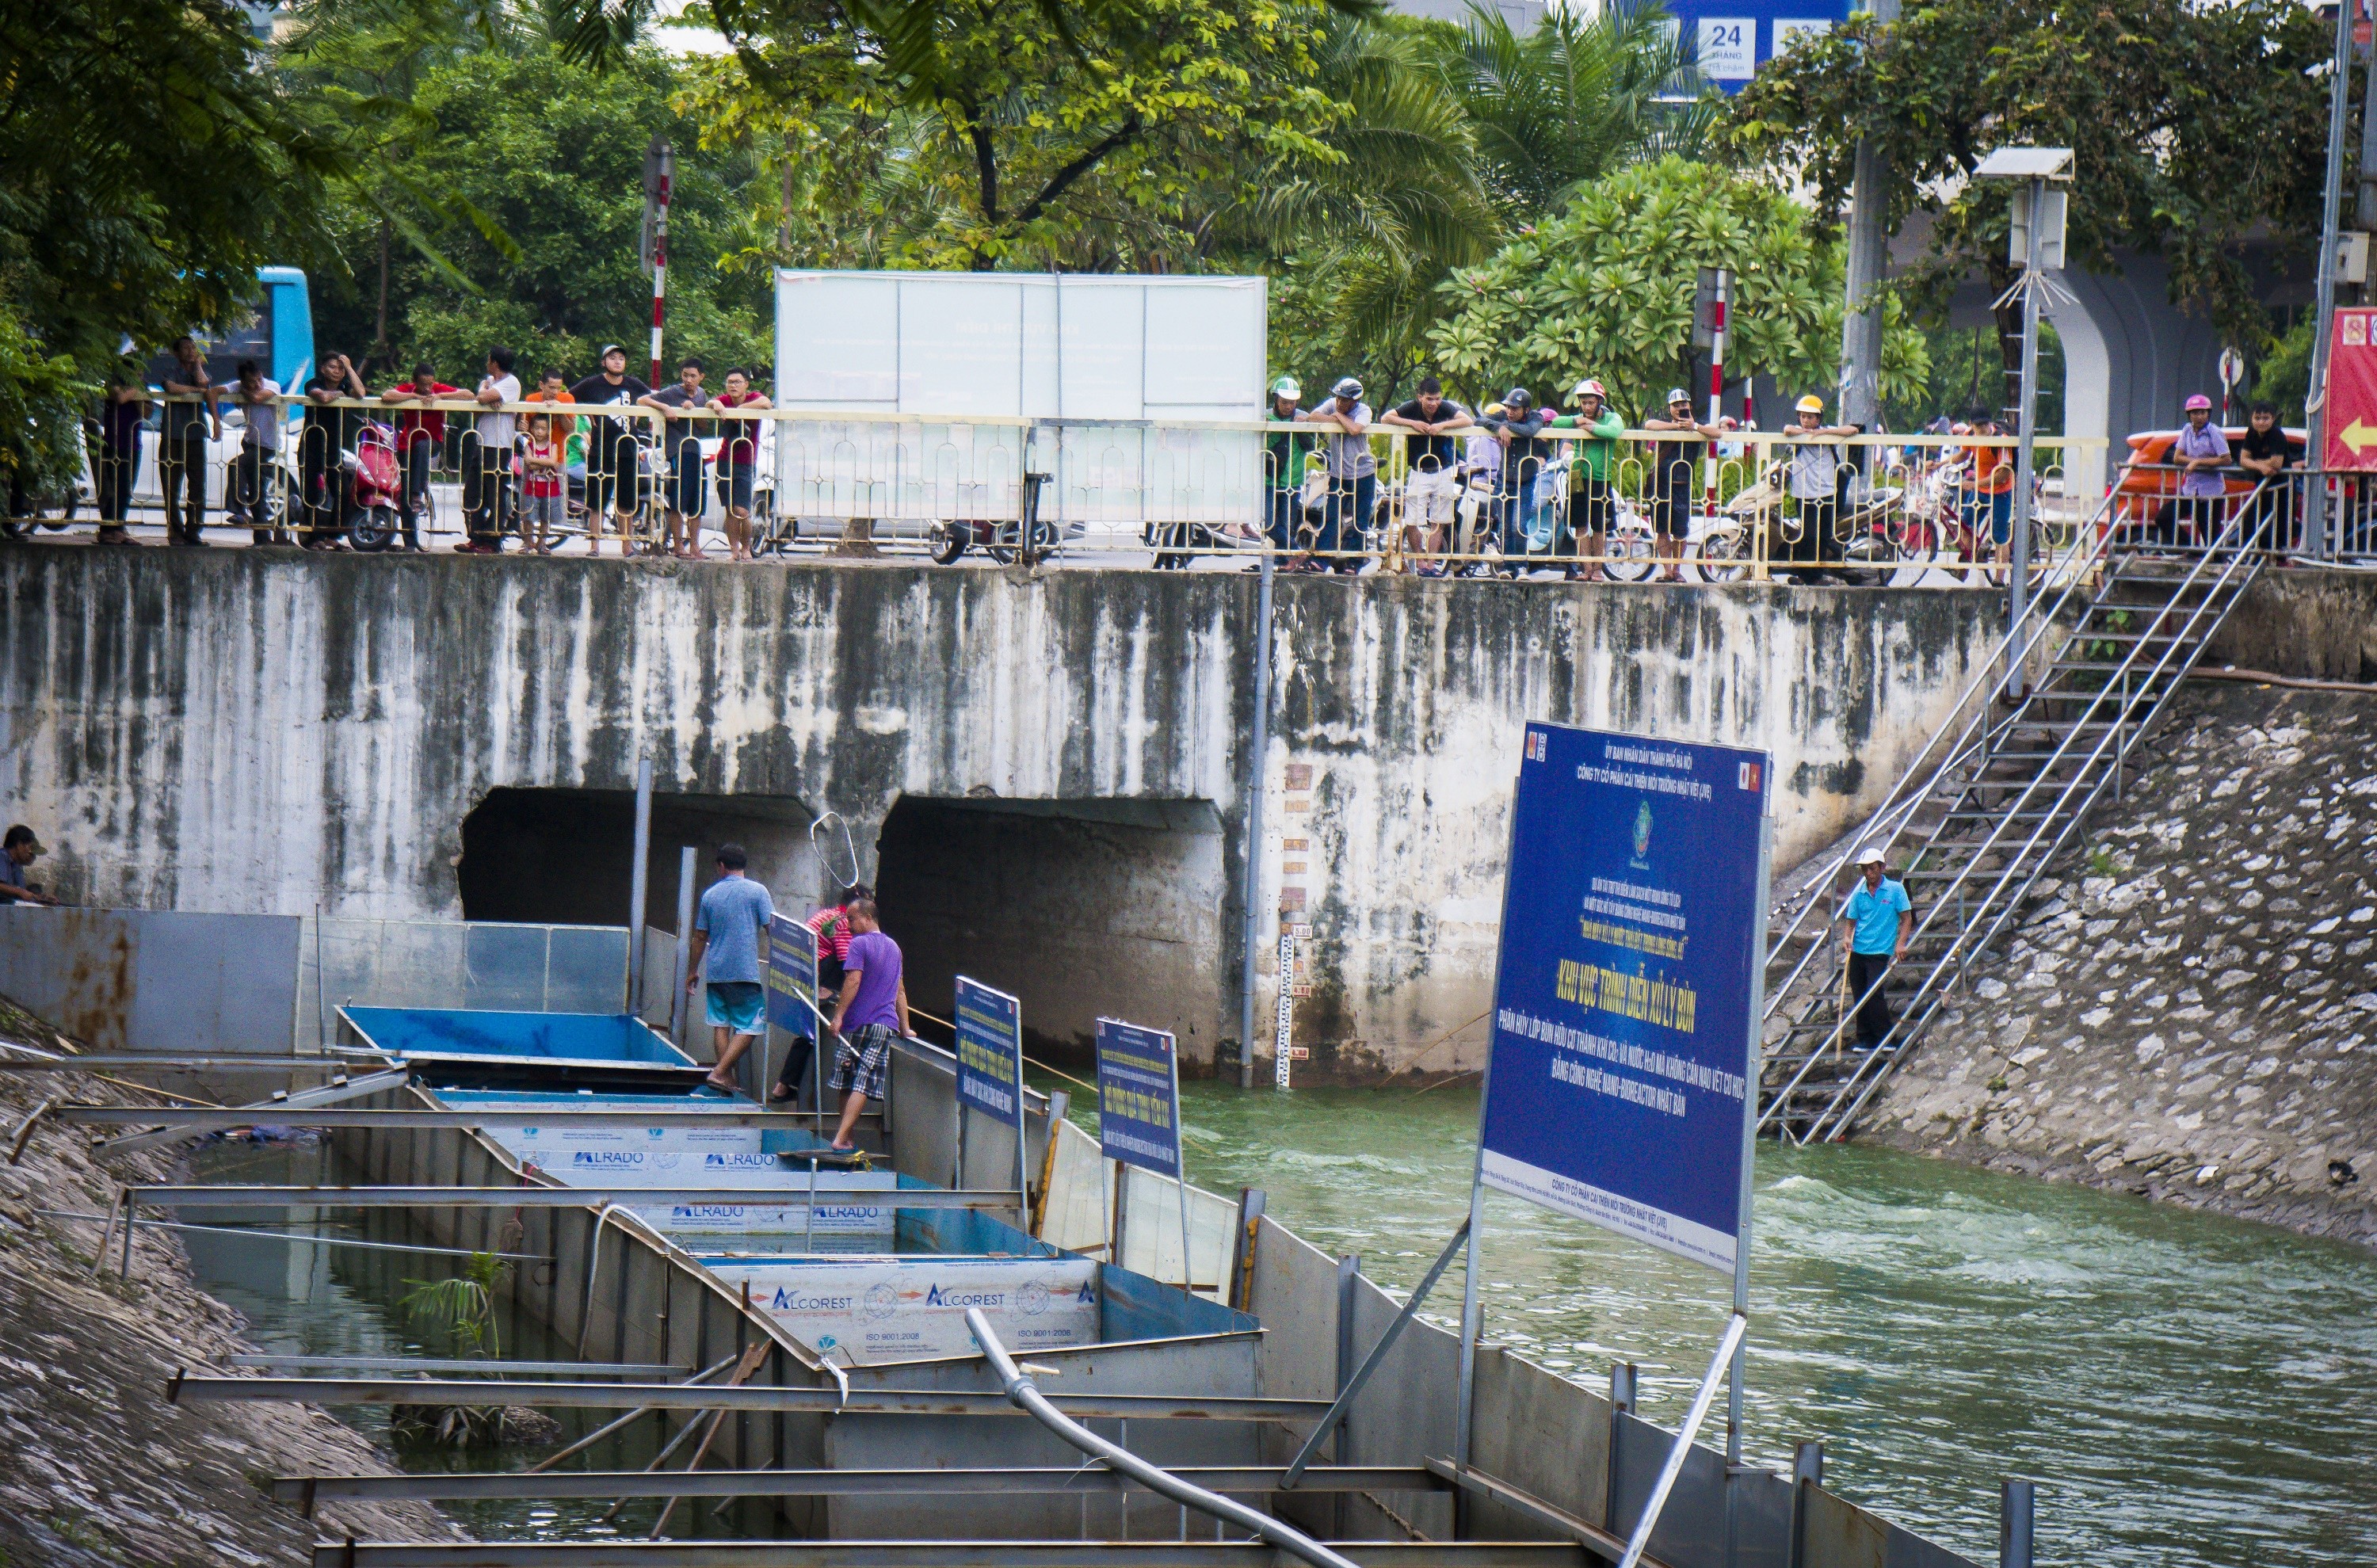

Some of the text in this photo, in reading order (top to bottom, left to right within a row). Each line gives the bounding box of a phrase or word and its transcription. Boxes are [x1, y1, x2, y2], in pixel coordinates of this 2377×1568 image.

[1711, 25, 1742, 47] 24
[1604, 739, 1692, 774] ỦY BAN NHÂN DÂN THÀNH PHỐ HÀ NỘI
[1577, 761, 1712, 803] CÔNG TY CỔ PHẦN CẢI THIỆN MÔI TRƯỜNG NHẬT VIỆT (JVE)
[1555, 958, 1696, 1034] KHU VỰC TRÌNH DIỄN XỬ LÝ BÙN
[1498, 1007, 1516, 1032] PHÂN
[1515, 1009, 1528, 1036] HỦY
[1528, 1014, 1541, 1040] LỚP
[1540, 1018, 1554, 1043] BÙN
[1553, 1021, 1567, 1047] HỮU
[1566, 1026, 1576, 1050] CƠ
[1575, 1028, 1597, 1055] THÀNH
[1596, 1034, 1608, 1059] KHÍ
[1618, 1040, 1627, 1065] VÀ
[1627, 1042, 1644, 1070] NƯỚC
[1655, 1049, 1665, 1076] MÀ
[1665, 1053, 1686, 1082] KHÔNG
[1685, 1055, 1699, 1086] CẦN
[1698, 1065, 1711, 1093] NẠO
[1711, 1065, 1723, 1093] VÉT
[1723, 1070, 1732, 1097] CƠ
[1731, 1074, 1746, 1103] HỌC
[1551, 1050, 1686, 1118] BẰNG CÔNG NGHỆ NANO-BIOREACTOR NHẬT BẢN
[574, 1152, 643, 1163] ALRADO
[705, 1154, 775, 1166] ARADO
[773, 1286, 853, 1309] ALCOREST
[925, 1282, 1005, 1307] ALCOREST
